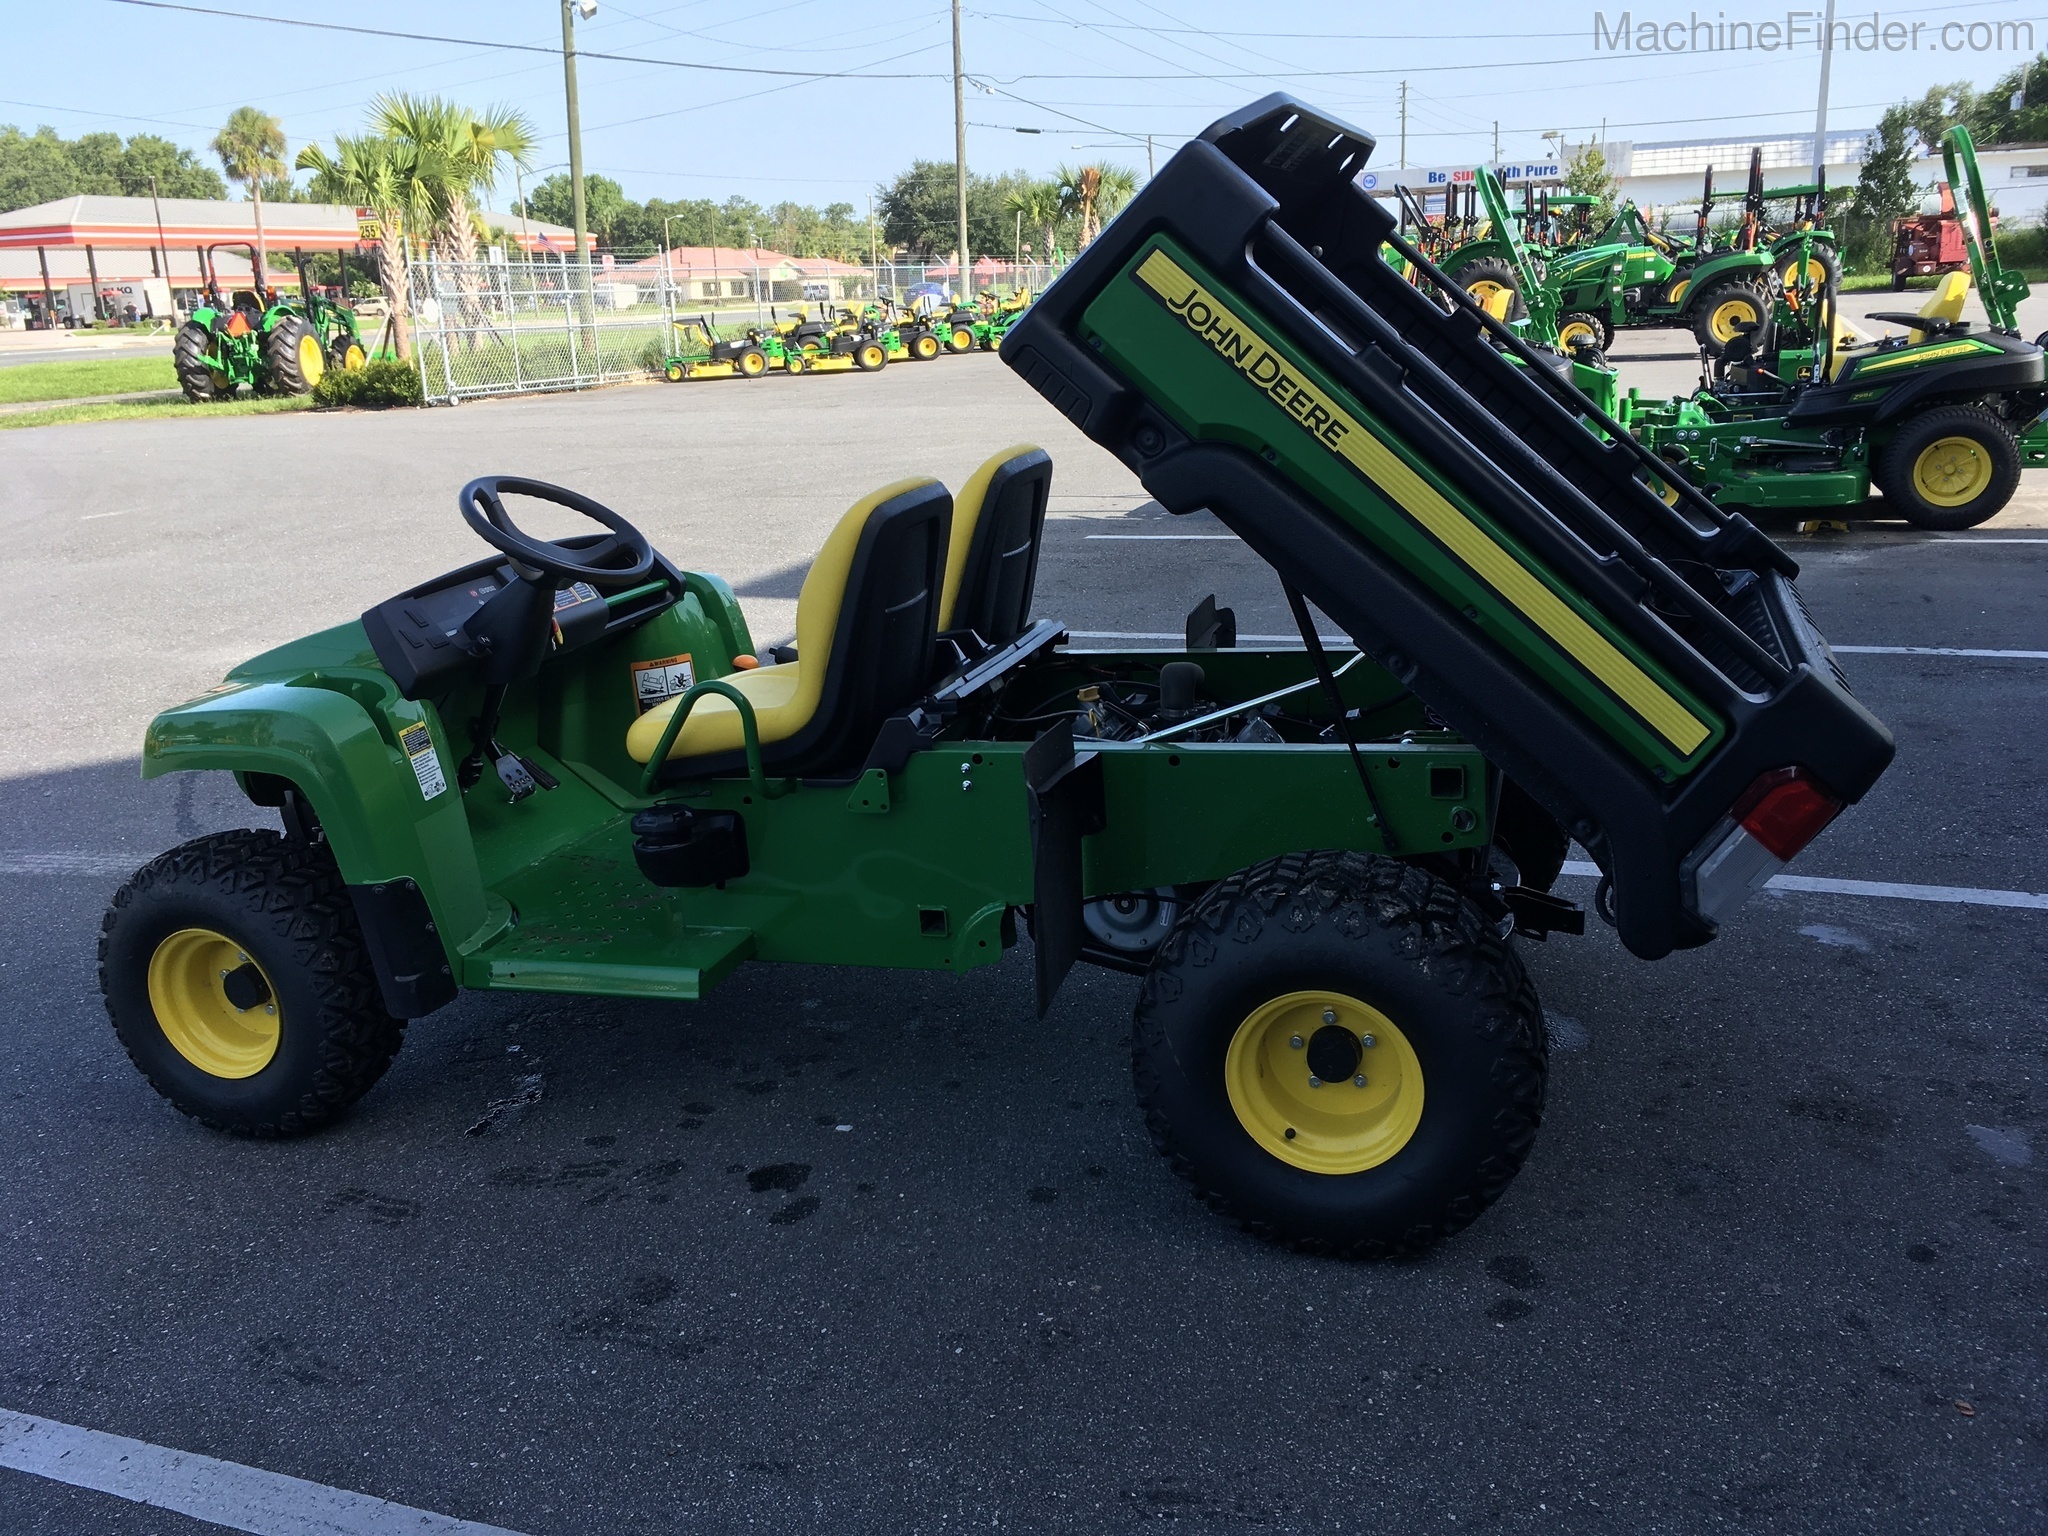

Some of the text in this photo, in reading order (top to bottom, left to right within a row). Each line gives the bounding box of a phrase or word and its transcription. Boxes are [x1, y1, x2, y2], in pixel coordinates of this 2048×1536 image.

[1428, 171, 1446, 183] Be
[1525, 164, 1558, 177] Pure
[360, 225, 376, 238] 255
[1918, 345, 1969, 360] JOHN DEERE
[1168, 288, 1349, 450] JOHN DEERE
